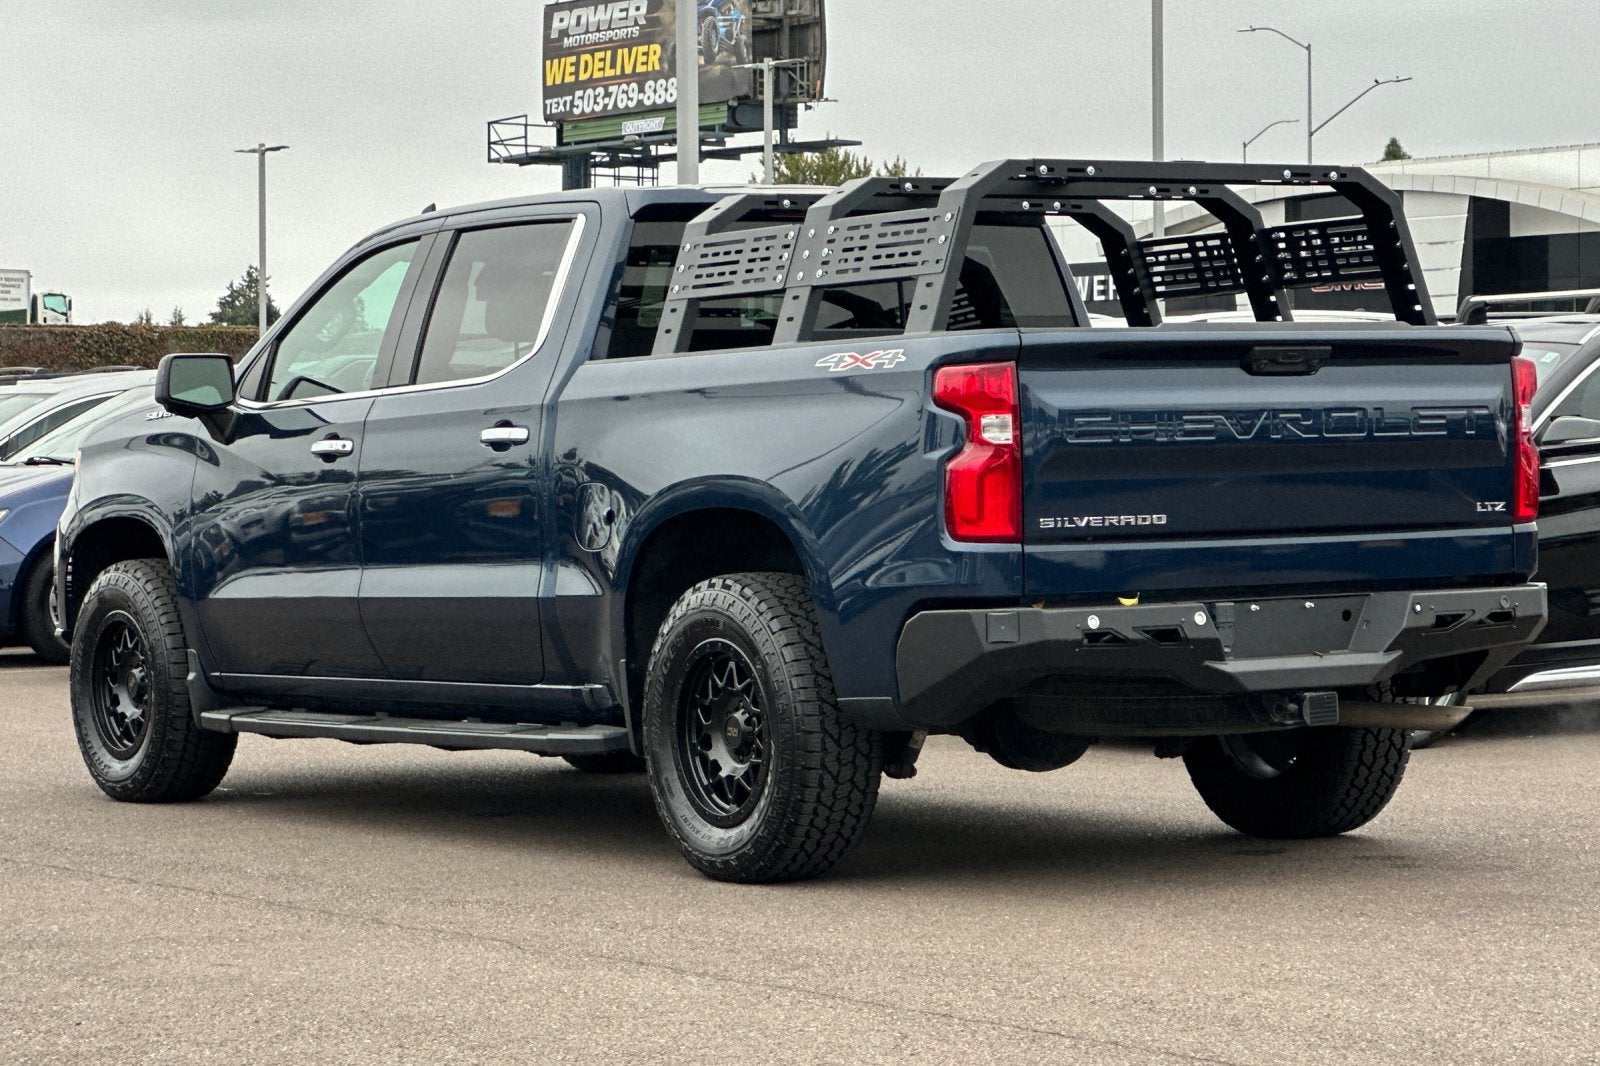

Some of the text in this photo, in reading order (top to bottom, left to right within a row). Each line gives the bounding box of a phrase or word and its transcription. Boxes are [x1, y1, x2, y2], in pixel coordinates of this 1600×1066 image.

[550, 0, 648, 38] POWER
[563, 26, 640, 48] MOTORSPORTS
[545, 43, 661, 86] WE DELIVER
[545, 95, 573, 115] TEXT
[1066, 405, 1490, 443] CHEVROLET
[1476, 501, 1506, 512] LTZ
[1039, 514, 1167, 529] SILVERADO
